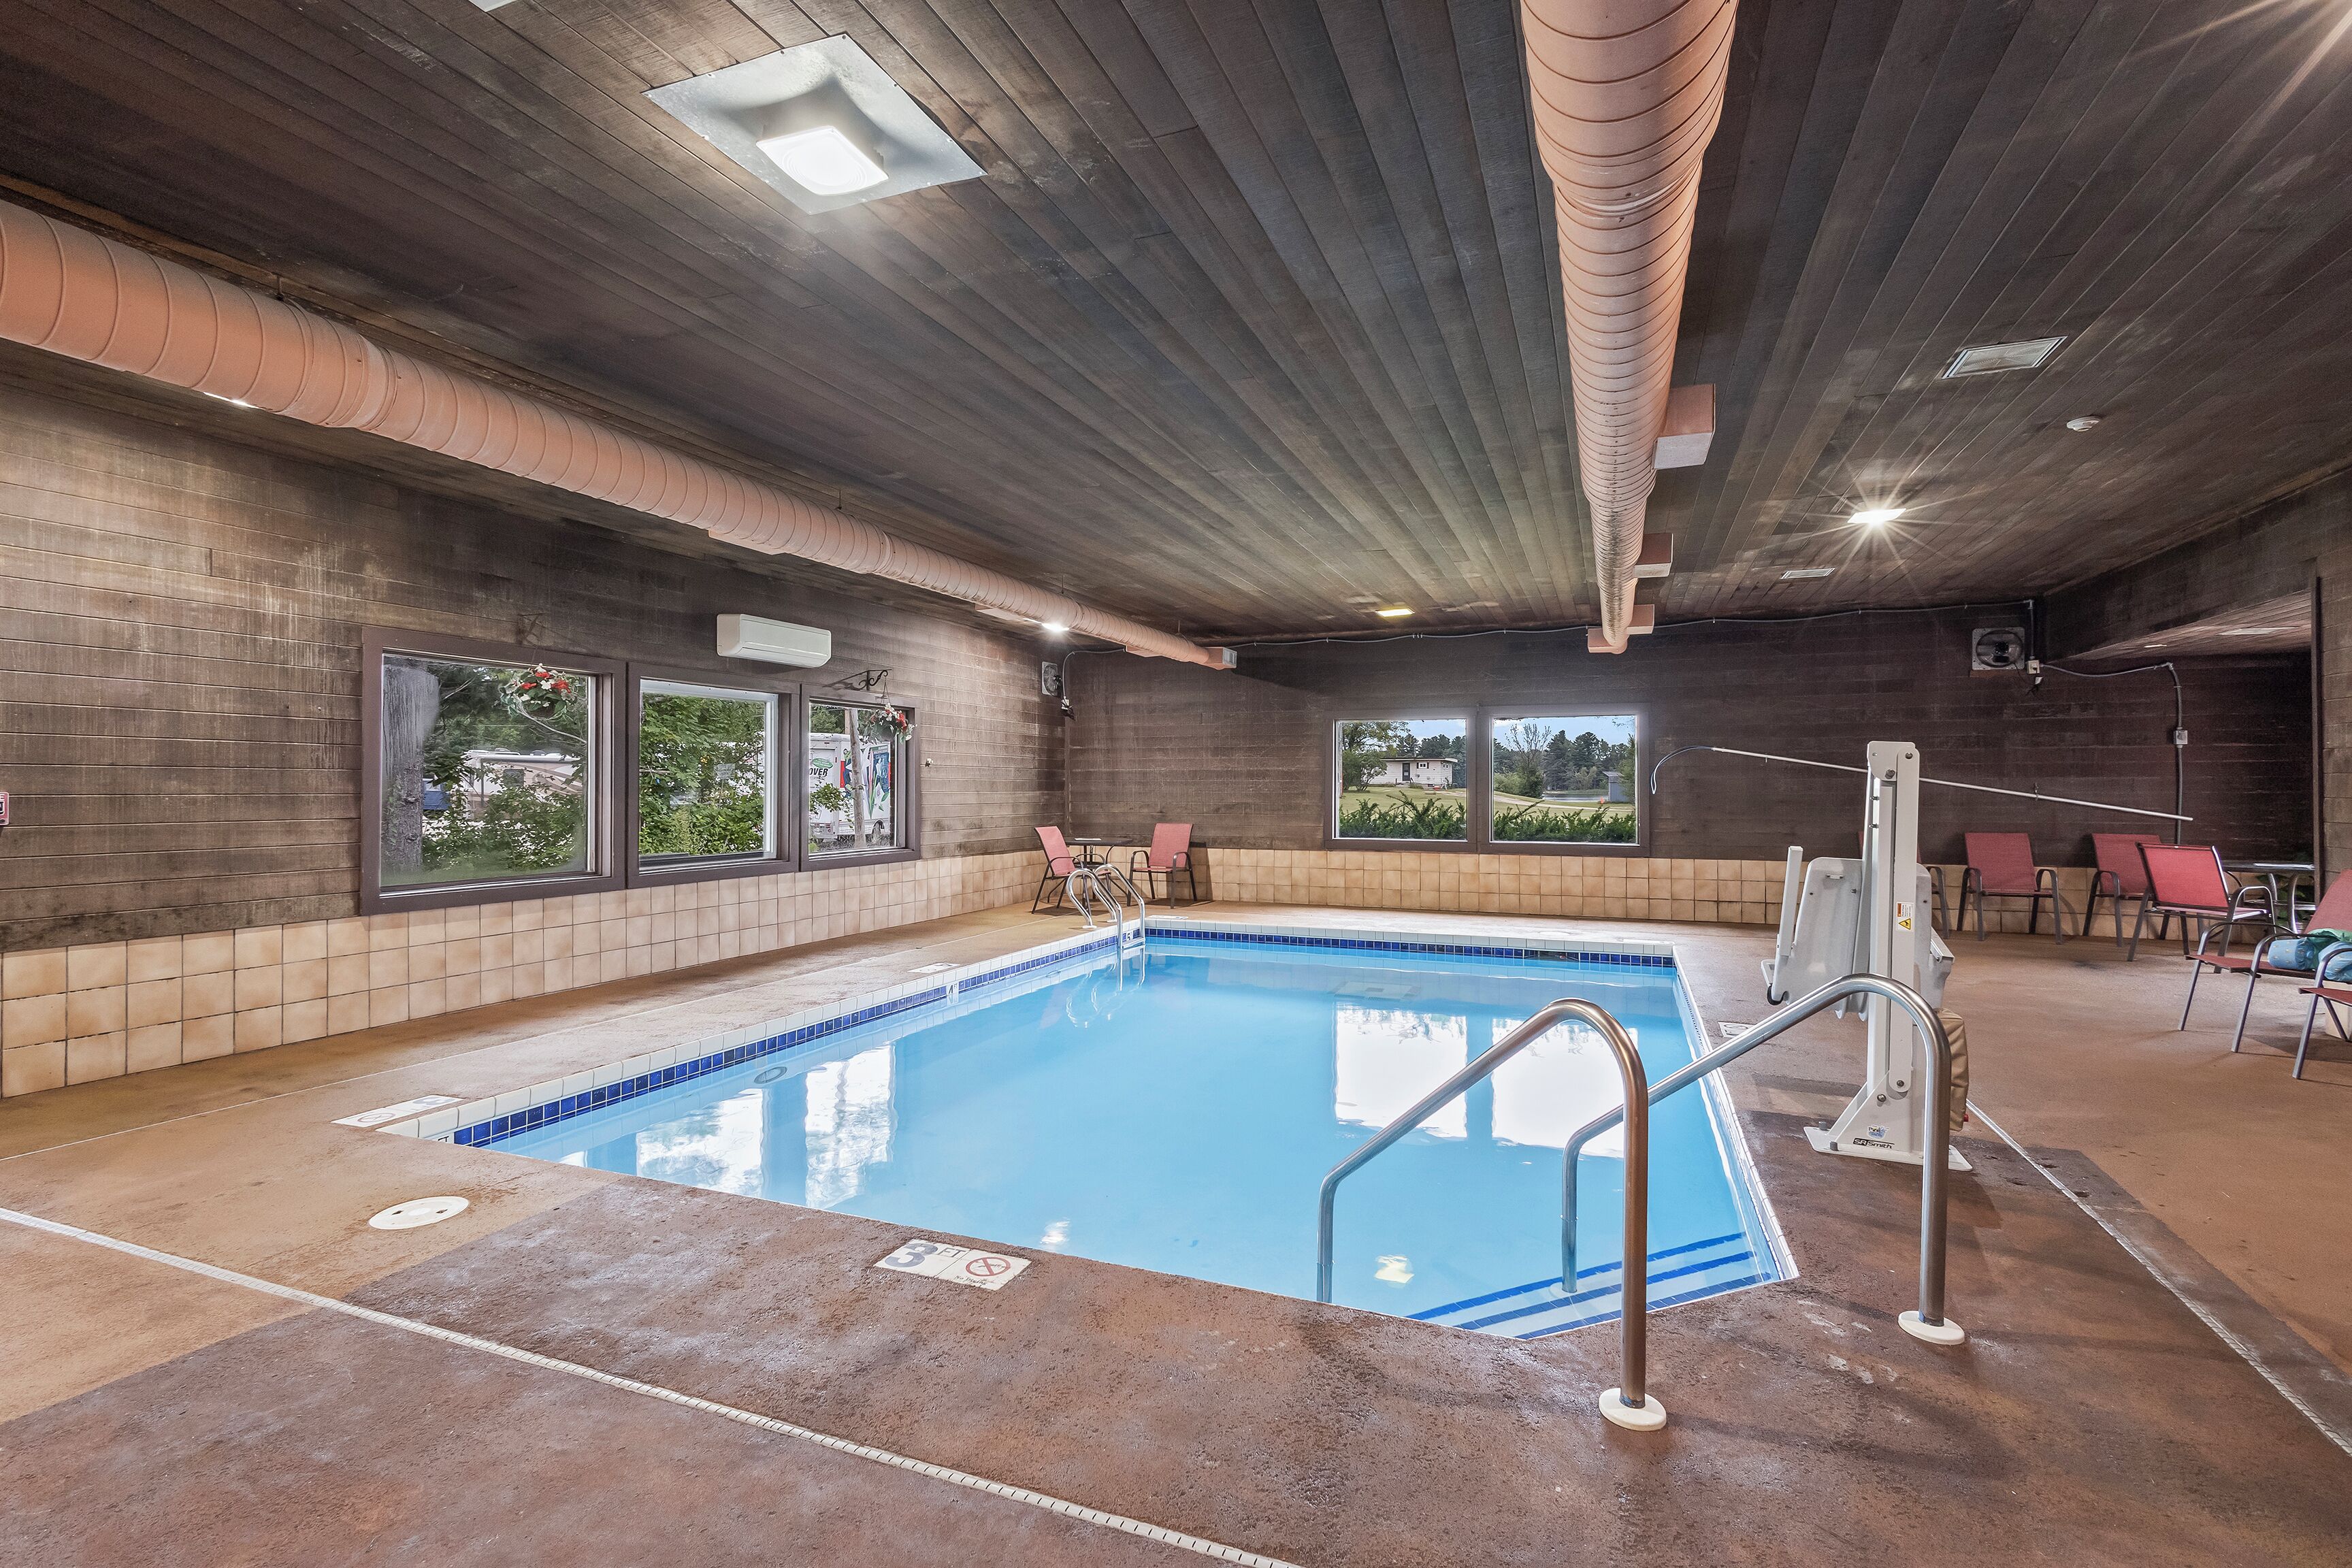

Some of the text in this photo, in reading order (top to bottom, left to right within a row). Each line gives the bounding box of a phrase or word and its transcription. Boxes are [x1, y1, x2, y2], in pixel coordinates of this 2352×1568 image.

[1867, 1140, 1893, 1149] Smith
[884, 1243, 966, 1268] 3 FT
